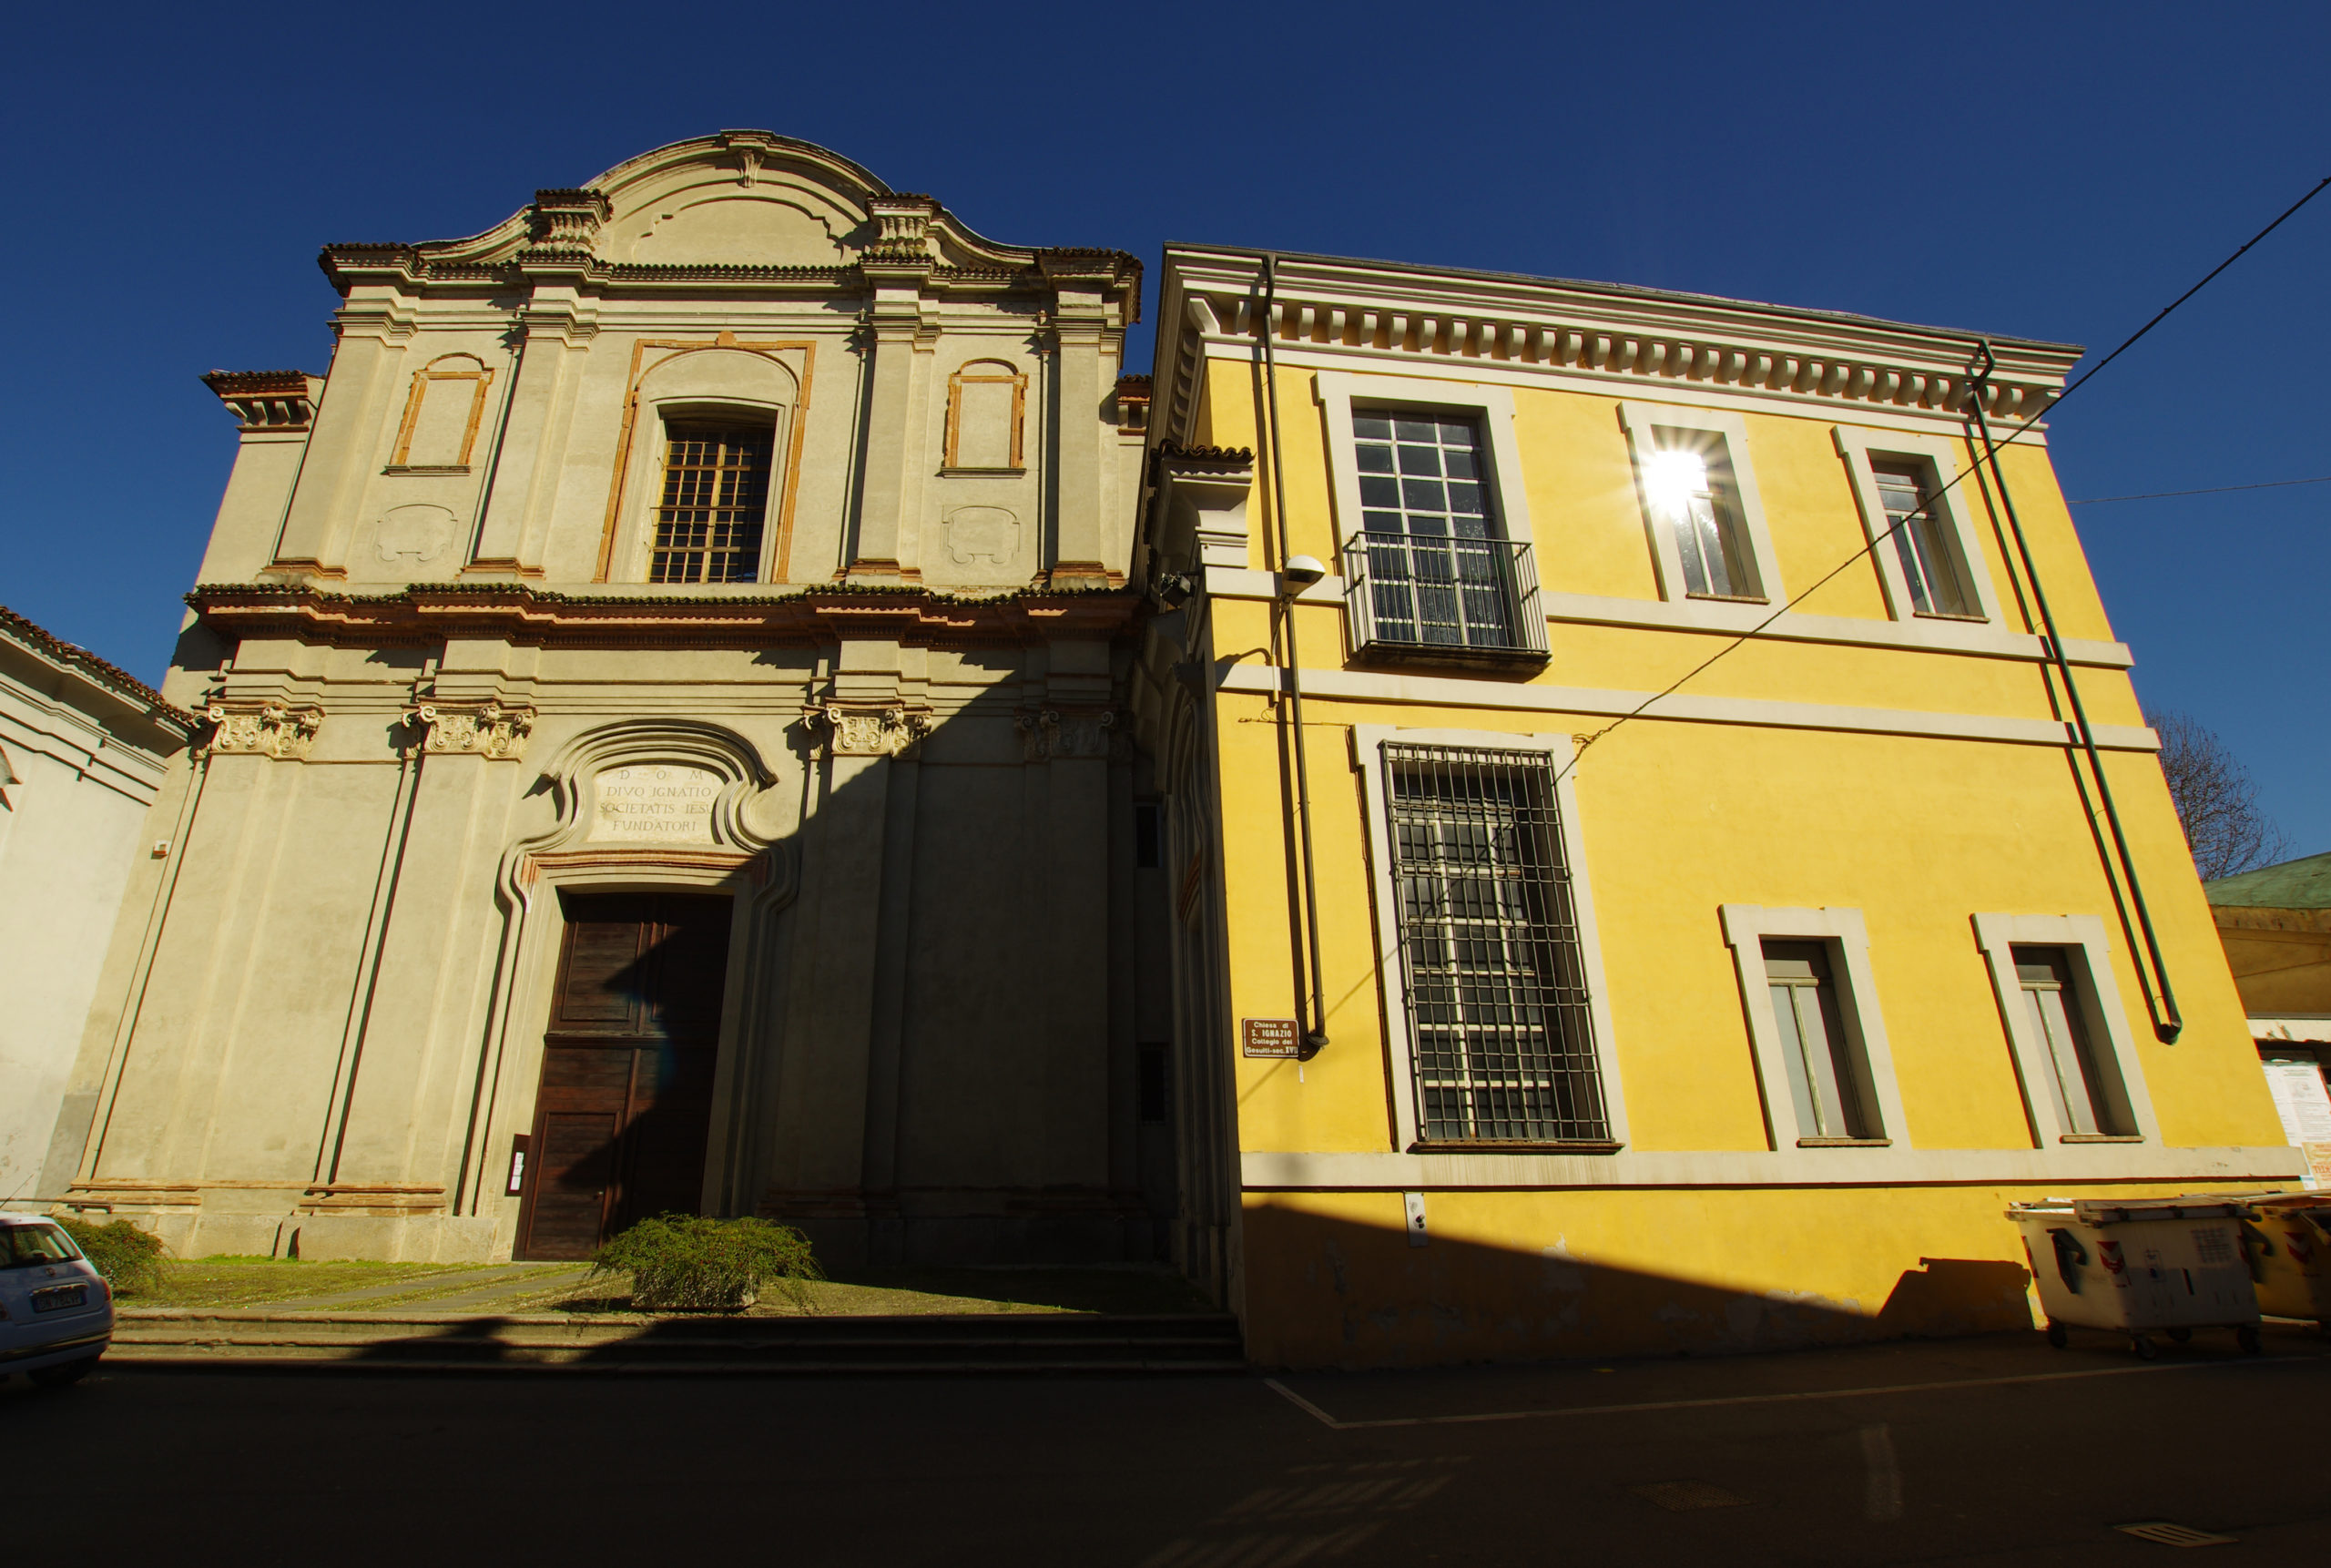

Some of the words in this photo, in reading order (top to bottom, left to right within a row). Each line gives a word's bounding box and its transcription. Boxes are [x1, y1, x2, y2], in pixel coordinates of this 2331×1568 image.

[620, 769, 630, 780] D
[657, 769, 667, 780] O
[688, 770, 703, 780] M
[606, 786, 645, 797] DIVO
[599, 802, 675, 814] SOCIETATIS
[613, 820, 697, 831] FUNDATORI
[1262, 1029, 1292, 1037] IGNAZIO
[1252, 1037, 1279, 1045] Collegio
